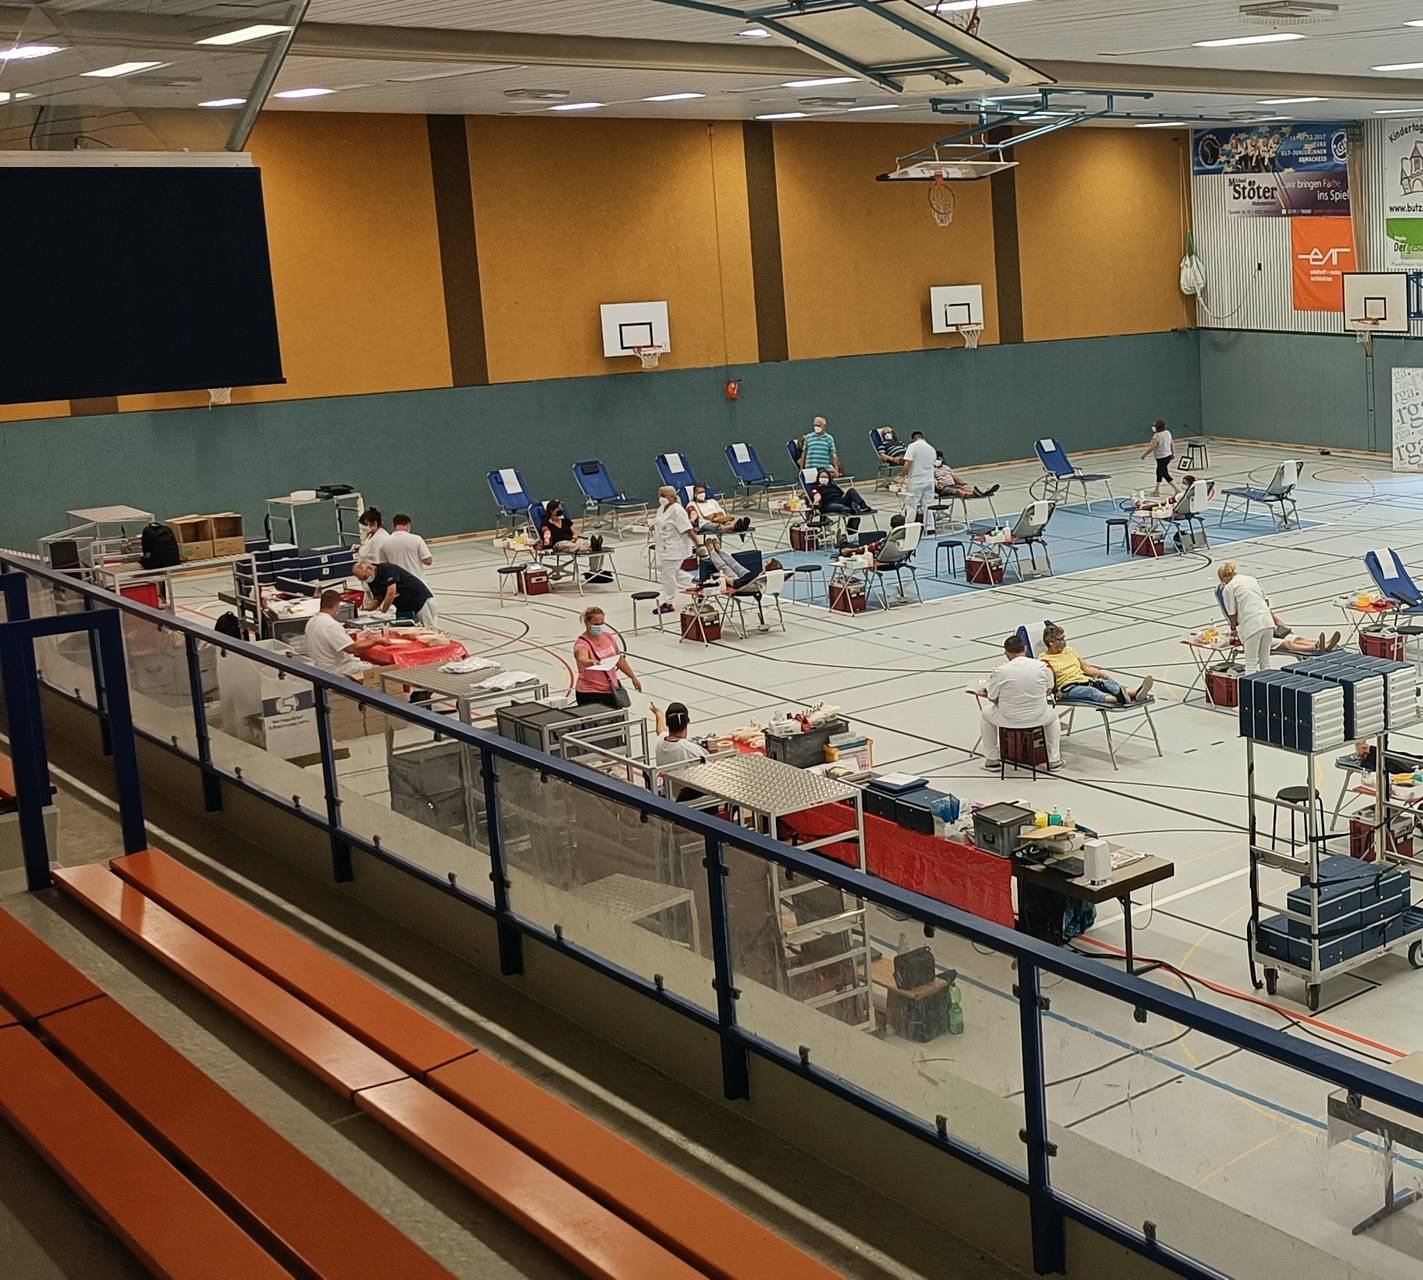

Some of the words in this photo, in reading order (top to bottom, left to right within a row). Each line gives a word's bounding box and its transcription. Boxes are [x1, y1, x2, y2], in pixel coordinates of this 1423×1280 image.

[1232, 179, 1278, 201] Stöter
[1297, 179, 1322, 190] bringen
[1317, 189, 1329, 200] ins
[1393, 242, 1406, 252] Der
